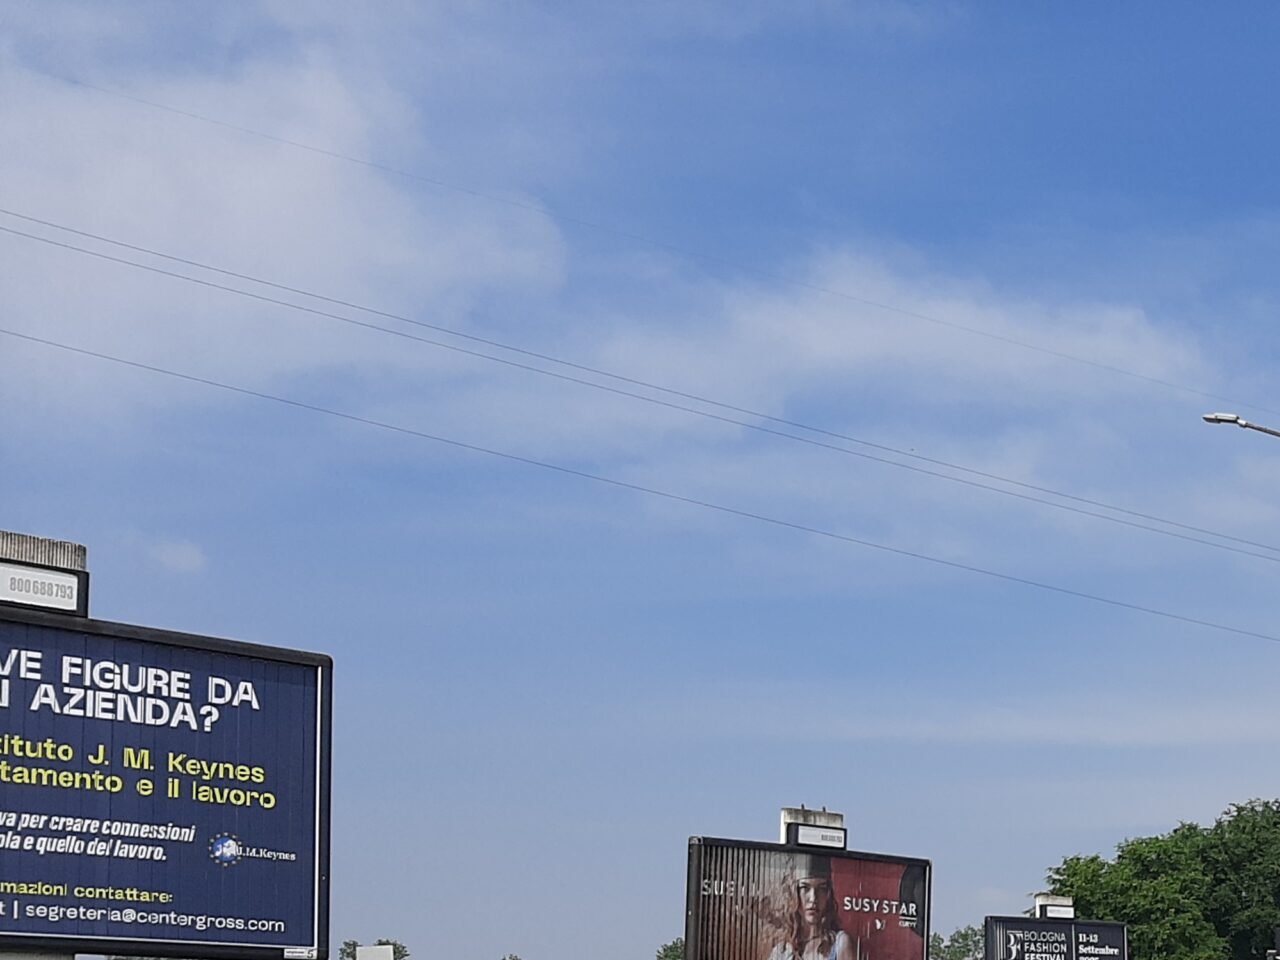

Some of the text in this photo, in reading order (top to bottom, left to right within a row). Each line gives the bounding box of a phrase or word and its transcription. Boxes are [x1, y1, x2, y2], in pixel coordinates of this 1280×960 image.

[62, 655, 191, 699] FIGURE
[208, 676, 260, 710] DA
[30, 683, 219, 732] AZIENDA?
[0, 734, 265, 783] ituto J. M. Keynes
[136, 779, 153, 796] e
[168, 777, 179, 798] il
[192, 781, 276, 809] lavoro
[17, 813, 48, 831] per
[49, 815, 99, 833] creare
[102, 820, 196, 842] connessioni
[23, 835, 34, 850] e
[35, 835, 85, 855] quello
[86, 838, 113, 856] del
[113, 840, 167, 861] lavoro.
[74, 886, 173, 903] contattare:
[26, 904, 285, 932] segreteria@centergross.com
[1024, 931, 1066, 941] BOLOGNA
[1024, 942, 1067, 953] FASHION
